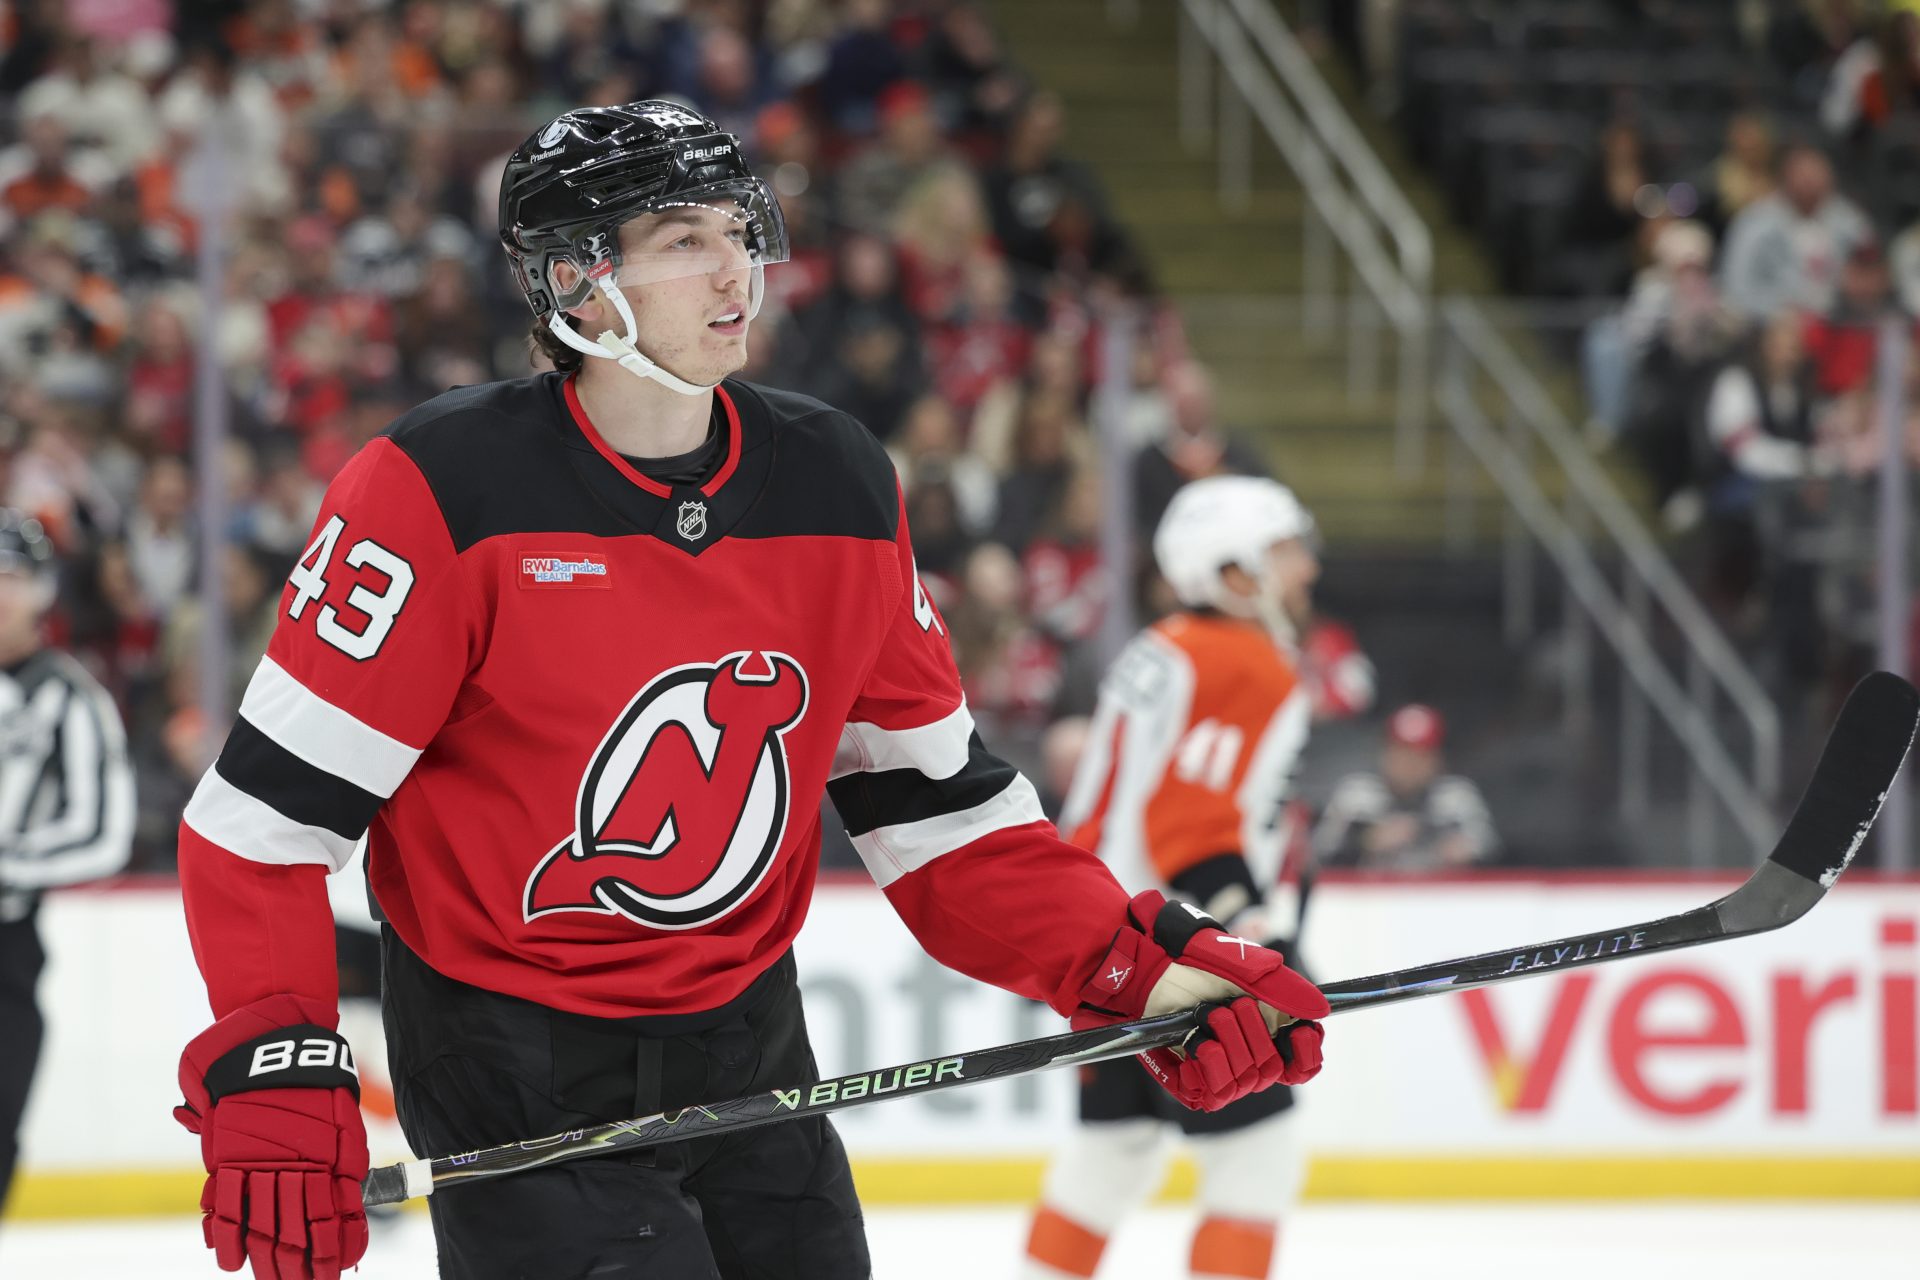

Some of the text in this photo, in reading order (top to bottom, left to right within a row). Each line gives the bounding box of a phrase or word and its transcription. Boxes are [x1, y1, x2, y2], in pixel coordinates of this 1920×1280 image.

[530, 145, 566, 164] Prudential
[683, 512, 701, 532] NHL
[287, 513, 417, 663] 43
[535, 572, 573, 582] HEALTH
[1503, 931, 1646, 974] FLYLITE
[807, 1057, 965, 1108] BAUER
